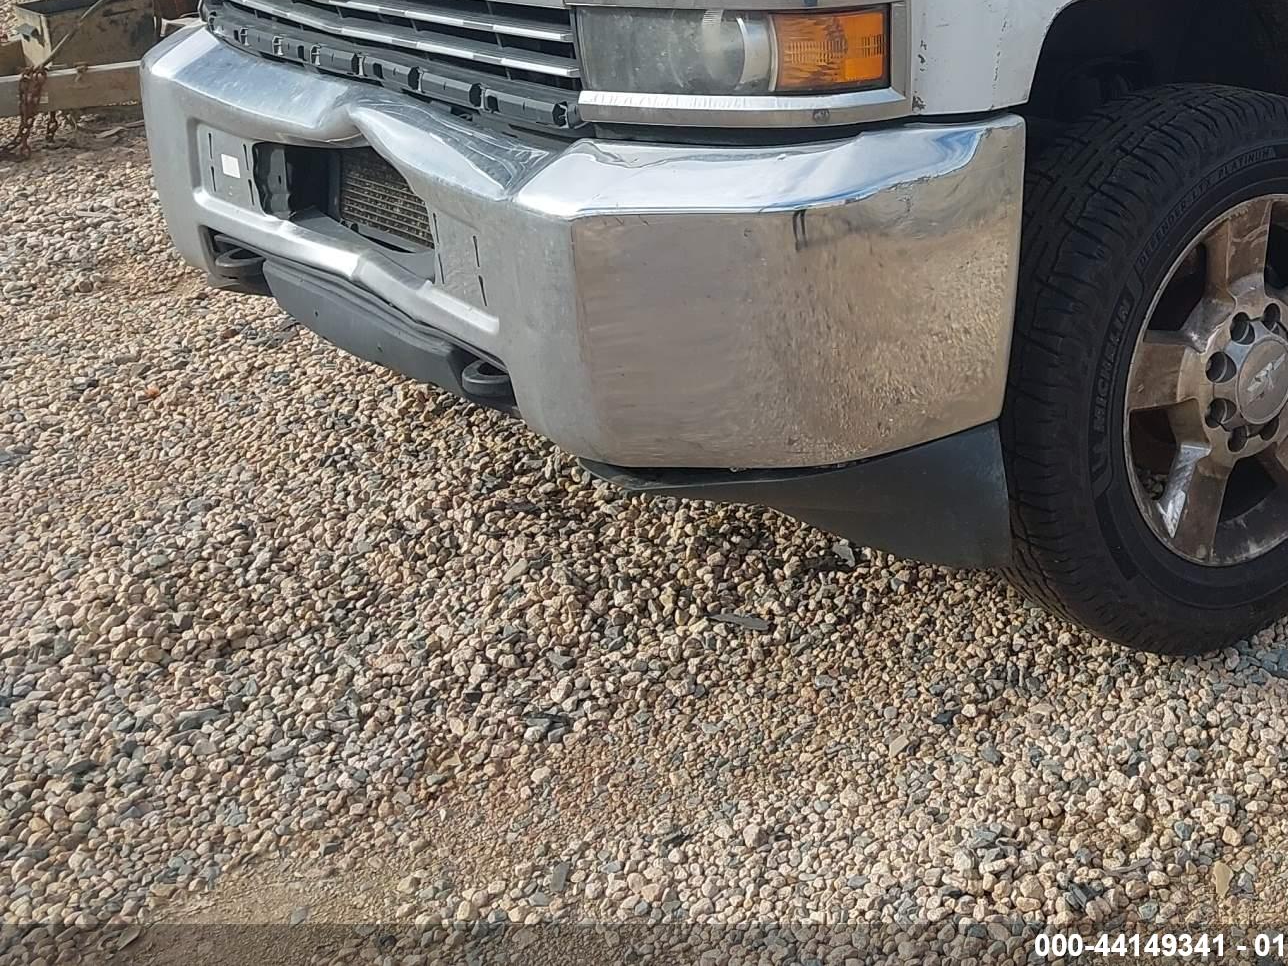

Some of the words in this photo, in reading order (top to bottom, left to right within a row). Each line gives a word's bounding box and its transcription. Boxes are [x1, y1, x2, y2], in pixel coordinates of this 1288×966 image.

[1139, 200, 1187, 266] DEFENDER
[1192, 179, 1211, 203] LTX
[1217, 145, 1273, 179] PLATINUM
[1093, 299, 1130, 433] MICHELIN
